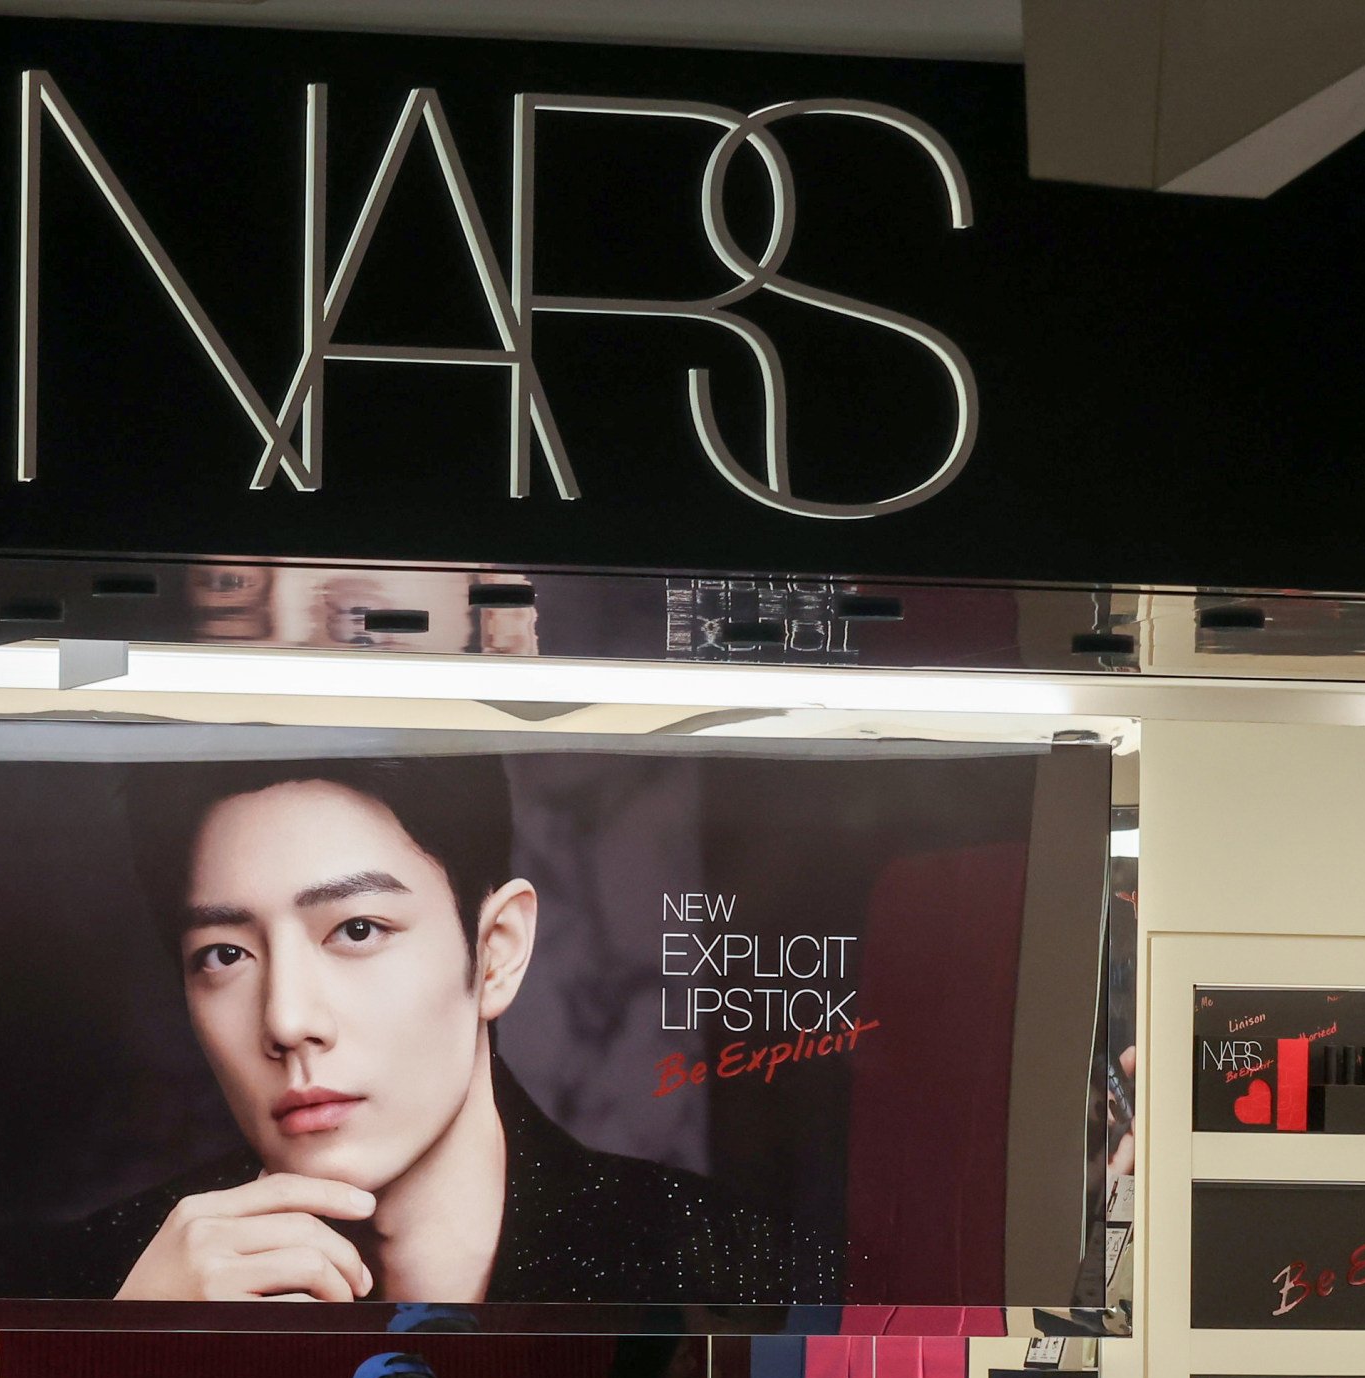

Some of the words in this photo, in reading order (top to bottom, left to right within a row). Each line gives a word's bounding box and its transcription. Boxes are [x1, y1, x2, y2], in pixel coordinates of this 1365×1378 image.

[16, 69, 978, 519] NARS
[663, 892, 736, 923] NEW
[662, 933, 858, 979] EXPLICIT
[661, 987, 857, 1033] LIPSTICK
[1229, 1012, 1266, 1034] Liaison
[651, 1052, 708, 1098] Be
[716, 1017, 881, 1084] Explicit
[1202, 1040, 1263, 1071] NARS
[1272, 1260, 1334, 1317] Be
